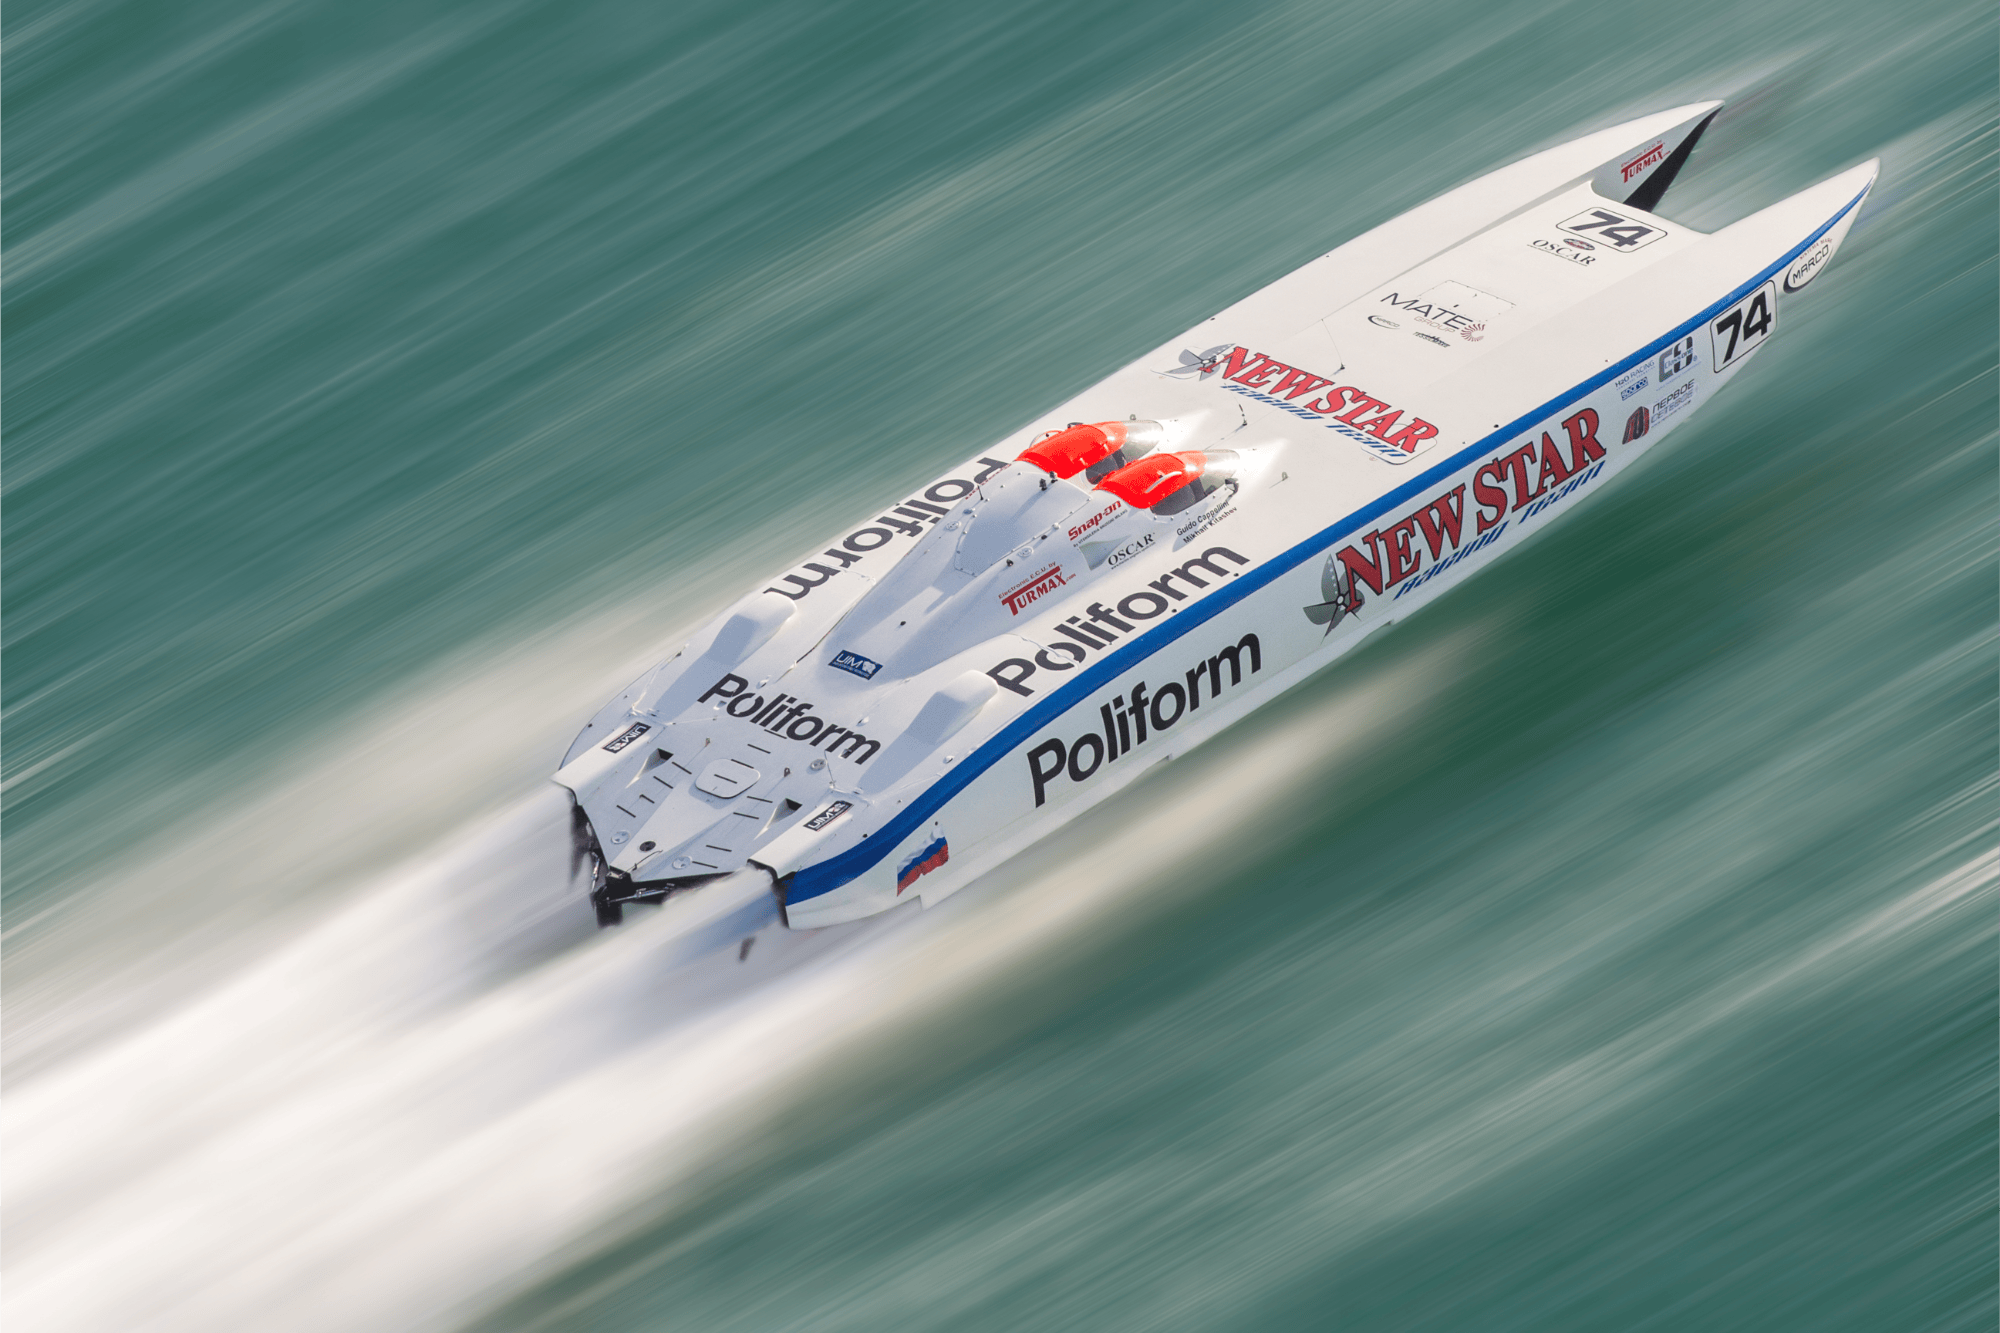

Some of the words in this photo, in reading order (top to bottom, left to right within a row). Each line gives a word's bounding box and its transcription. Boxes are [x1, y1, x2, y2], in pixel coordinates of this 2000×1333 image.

[1568, 210, 1654, 247] 74
[1533, 239, 1596, 265] OSCAR
[1792, 244, 1829, 284] MARCO
[1380, 292, 1473, 330] MATE
[1414, 315, 1456, 333] GROUP
[1716, 291, 1771, 364] 74
[1615, 374, 1630, 388] H2O
[1630, 359, 1655, 379] RACING
[1198, 346, 1336, 400] NEW
[1303, 386, 1439, 453] STAR
[1652, 378, 1695, 414] ПЕРВОЕ
[1068, 500, 1121, 541] Snap-on
[1176, 520, 1197, 536] Guido
[1197, 501, 1230, 523] Cappellini
[1183, 524, 1208, 543] Mikhail
[1208, 506, 1237, 527] Kitashev
[1336, 482, 1466, 613] NEW
[1473, 407, 1606, 536] STAR
[1108, 534, 1154, 566] OSCAR
[998, 577, 1029, 599] Electronic
[986, 546, 1250, 697] Poliform
[837, 653, 863, 668] UIM
[621, 725, 647, 743] UIM
[697, 673, 881, 765] Poliform
[1027, 633, 1261, 808] Poliform
[807, 812, 834, 829] UIM
